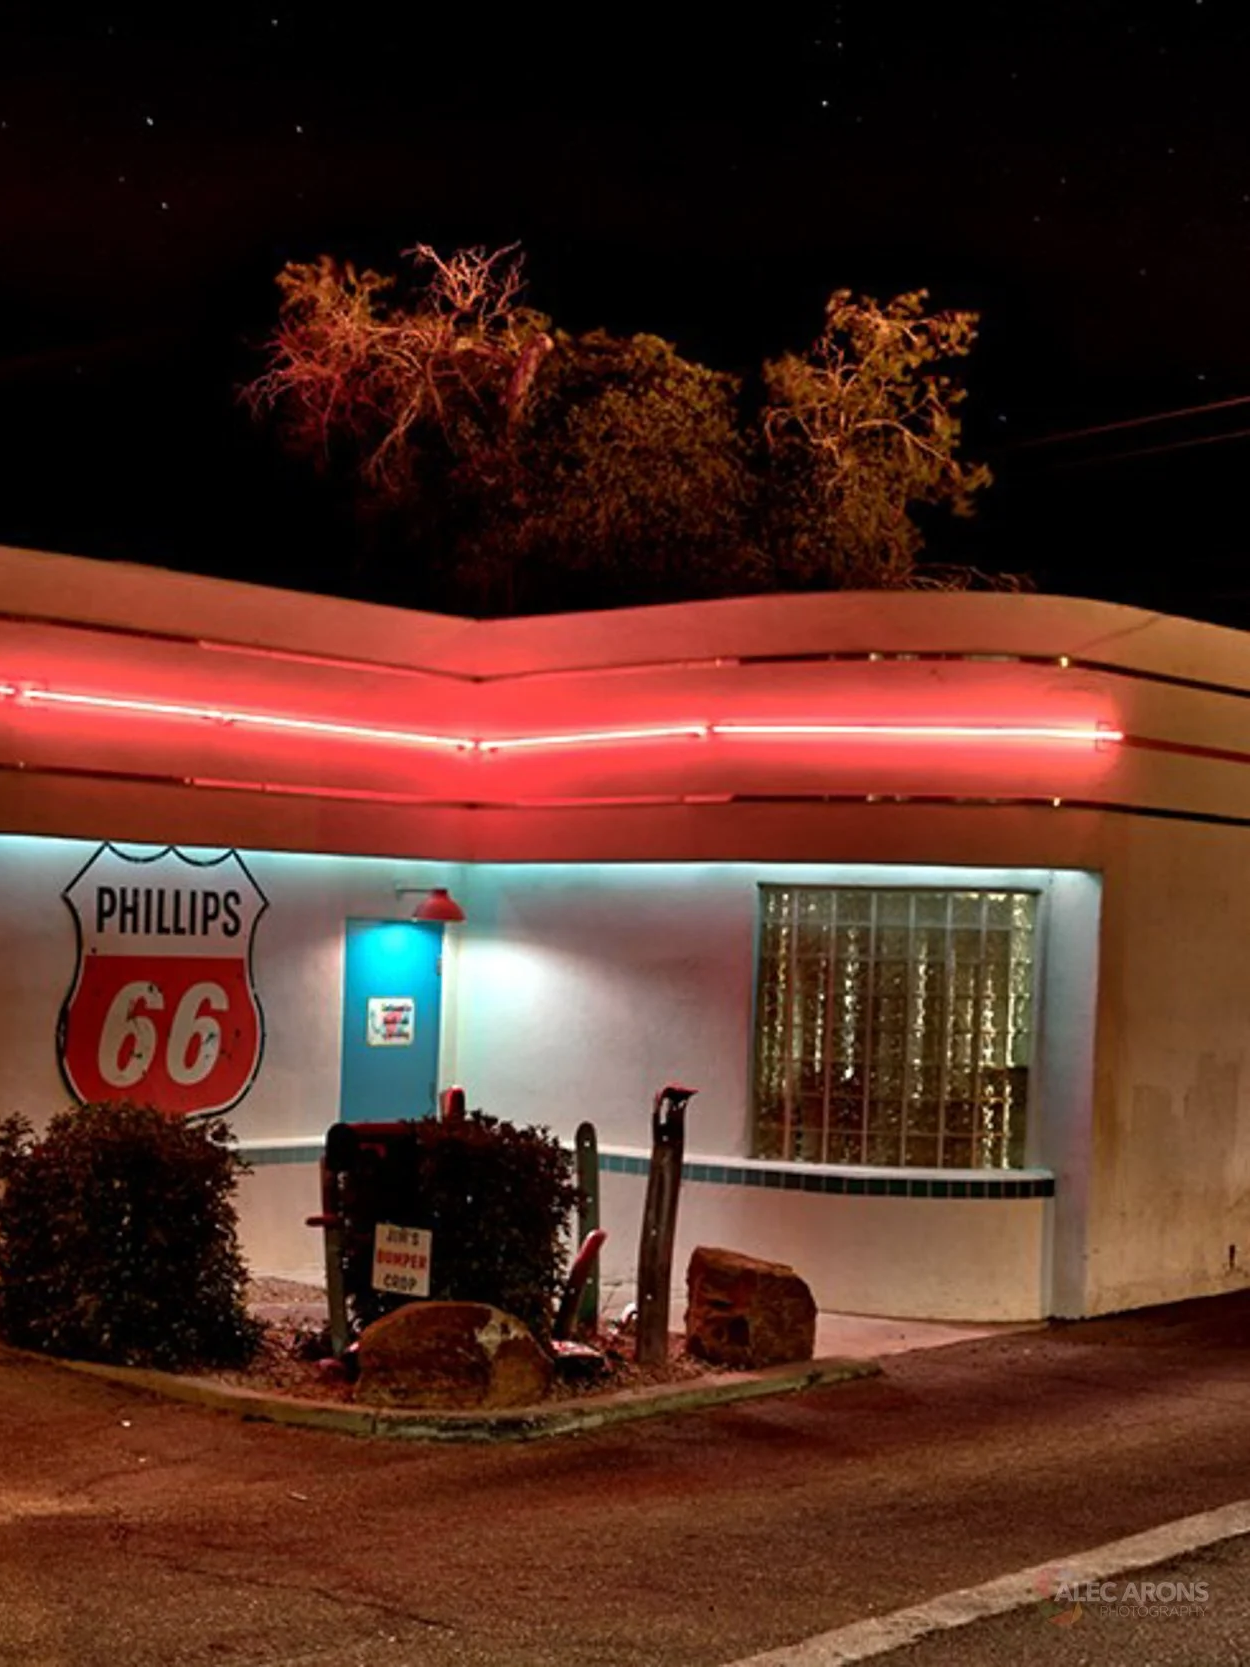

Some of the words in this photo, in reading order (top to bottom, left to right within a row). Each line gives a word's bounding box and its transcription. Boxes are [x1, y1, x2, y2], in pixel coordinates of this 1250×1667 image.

[96, 886, 242, 937] PHILLIPS
[97, 980, 230, 1087] 66
[386, 1228, 419, 1246] JIM'S
[377, 1249, 427, 1269] BUMPER
[383, 1273, 418, 1292] CROP
